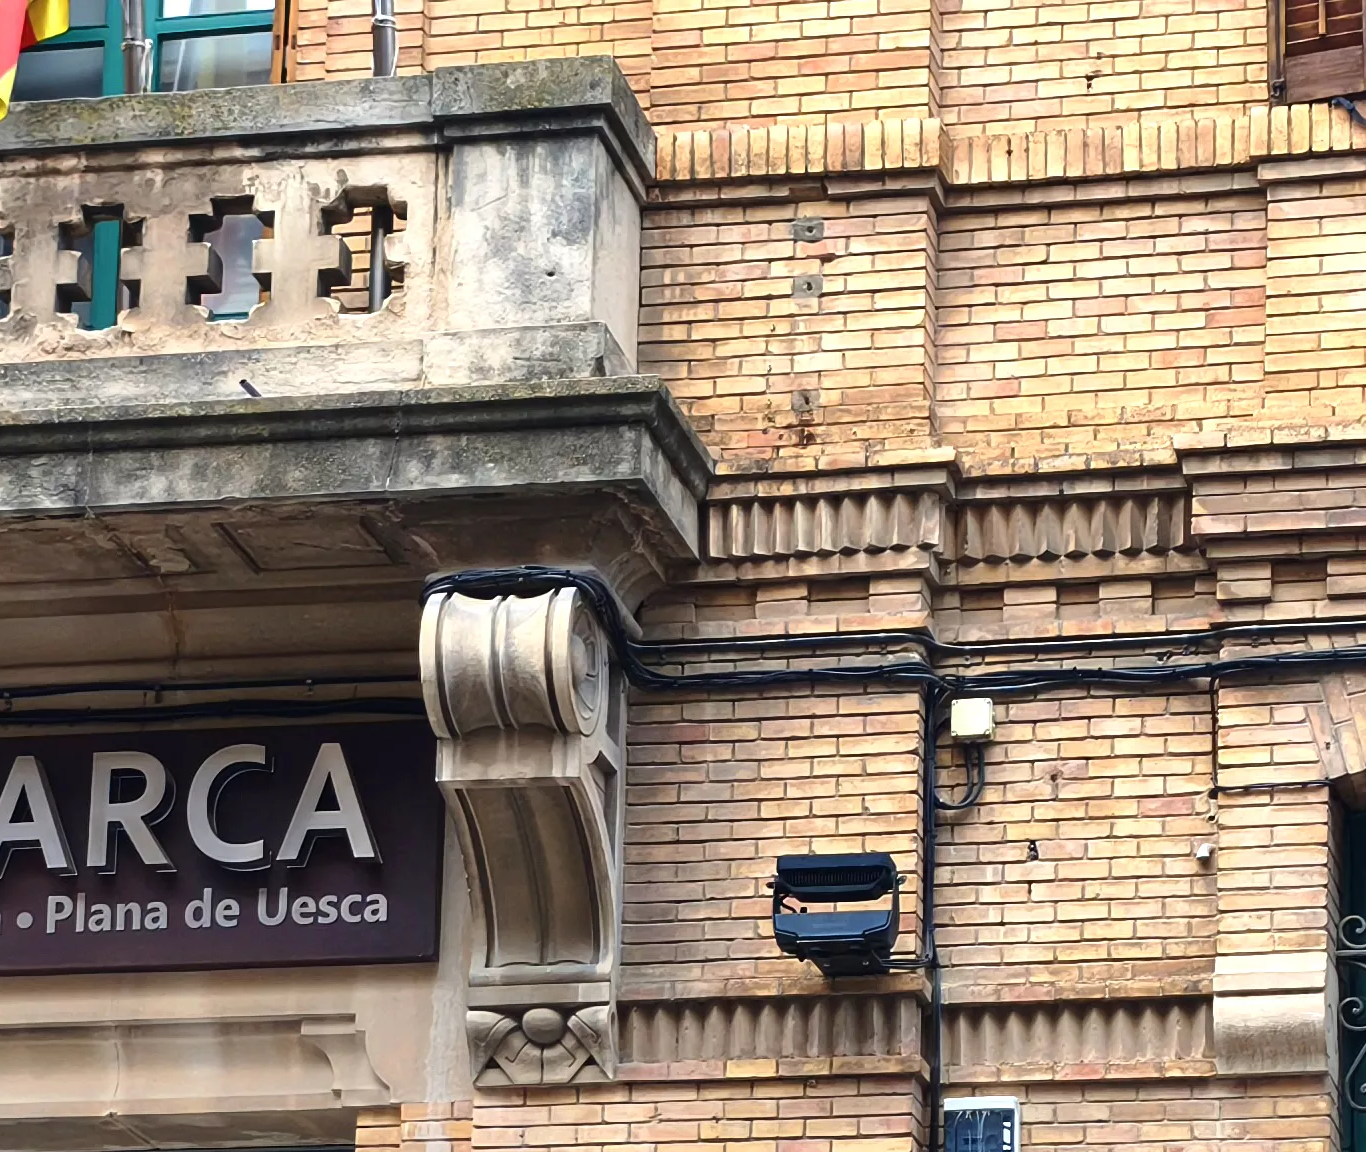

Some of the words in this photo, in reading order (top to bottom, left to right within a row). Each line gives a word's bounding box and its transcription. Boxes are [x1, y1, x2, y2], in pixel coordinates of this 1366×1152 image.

[45, 892, 167, 934] Plana
[183, 888, 239, 928] de
[256, 886, 388, 926] Uesca
